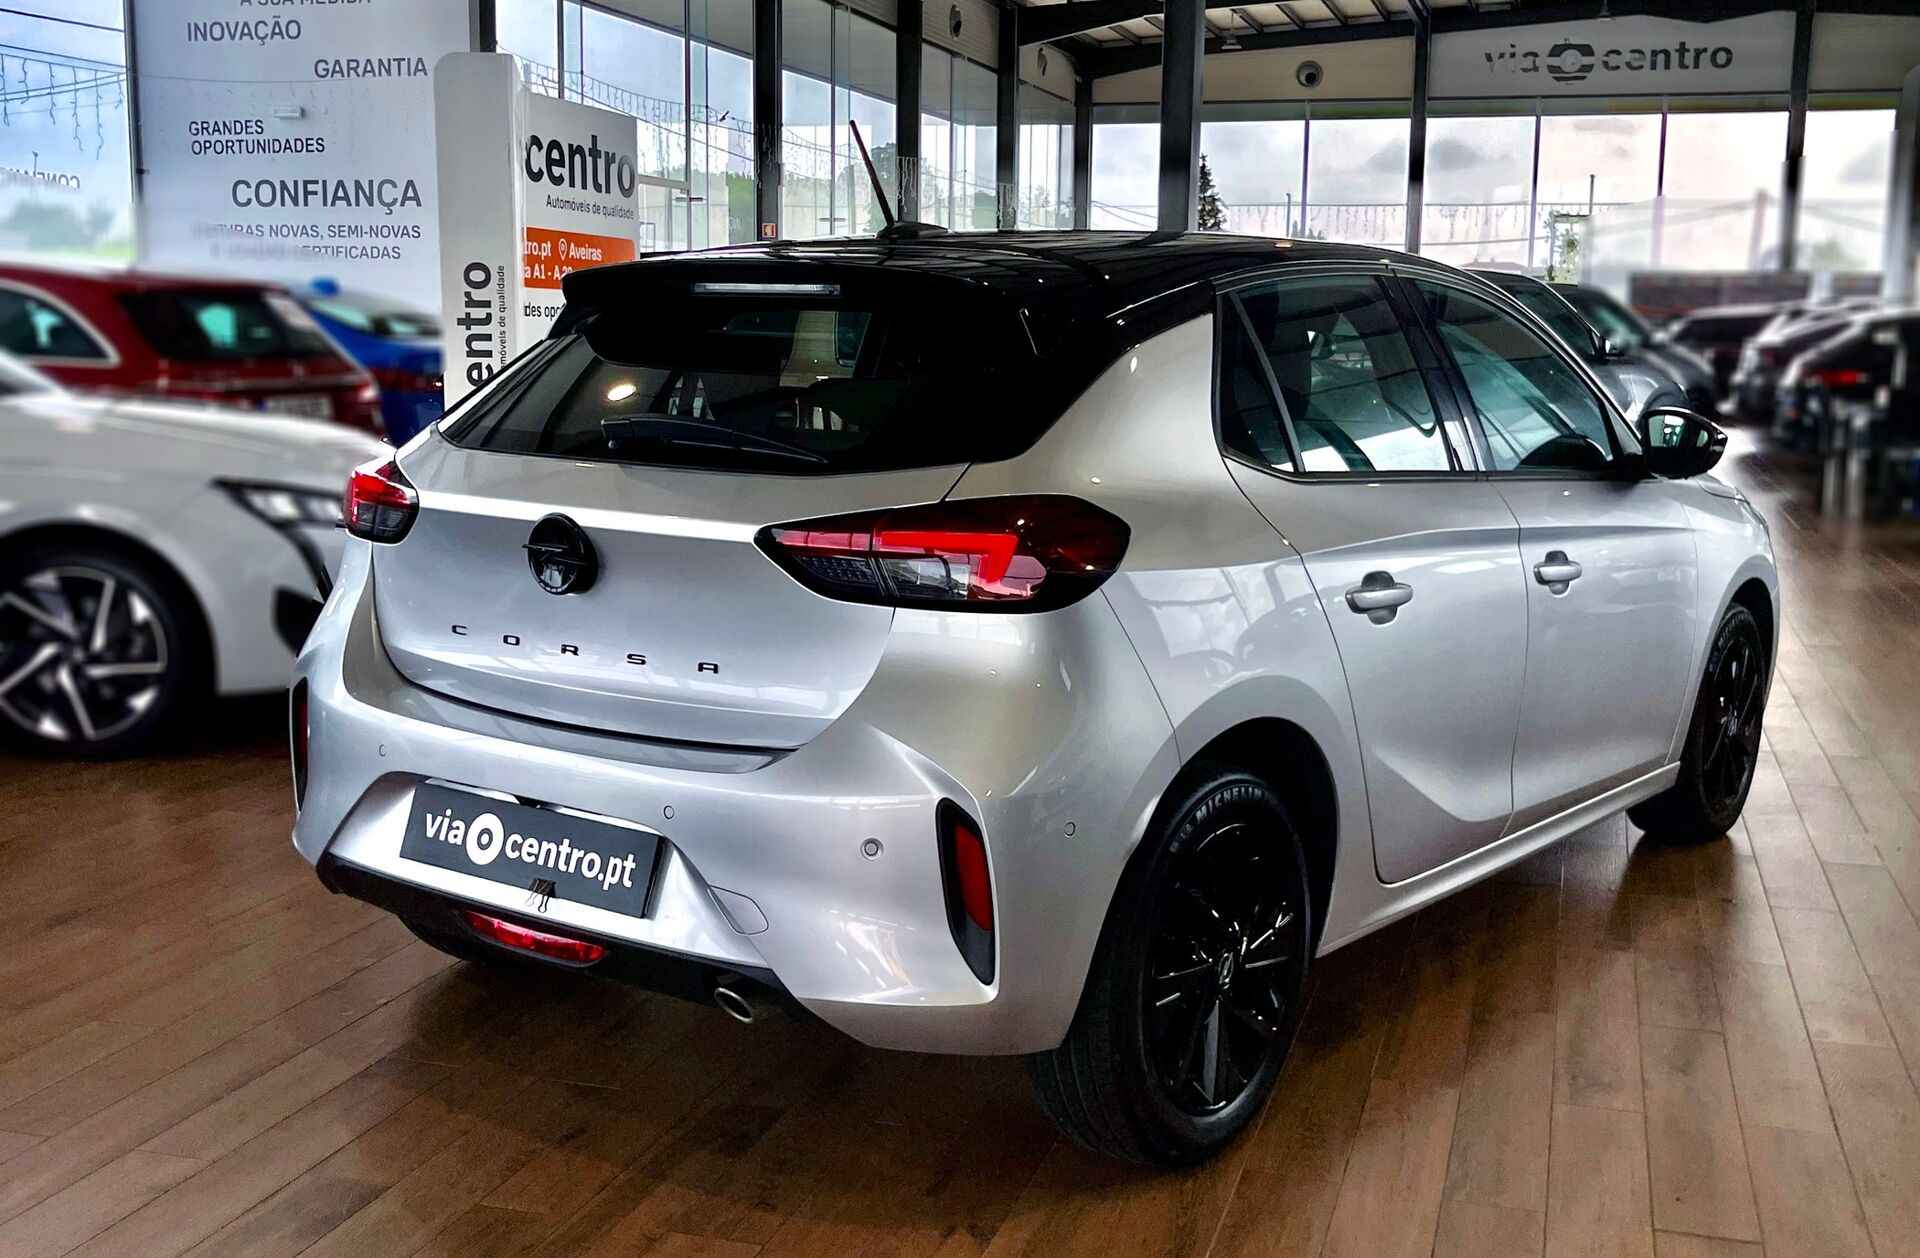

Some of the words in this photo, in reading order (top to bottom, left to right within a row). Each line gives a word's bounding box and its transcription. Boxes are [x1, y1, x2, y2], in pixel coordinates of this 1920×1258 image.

[186, 15, 301, 46] INOVAÇÃO
[314, 57, 429, 79] GARANTIA
[188, 119, 265, 136] GRANDES
[191, 137, 326, 156] OPORTUNIDADES
[524, 134, 636, 199] centro
[231, 178, 423, 216] CONFIANÇA
[546, 194, 591, 214] Automóveis
[592, 202, 601, 216] de
[602, 205, 635, 220] qualidade
[268, 223, 324, 241] NOVAS,
[327, 224, 422, 240] SEMI-NOVAS
[568, 242, 603, 262] Aveiras
[533, 263, 546, 280] A1
[497, 265, 508, 313] qualidade
[498, 315, 507, 328] de
[451, 624, 719, 675] CORSA
[1195, 785, 1264, 825] MICHELIN
